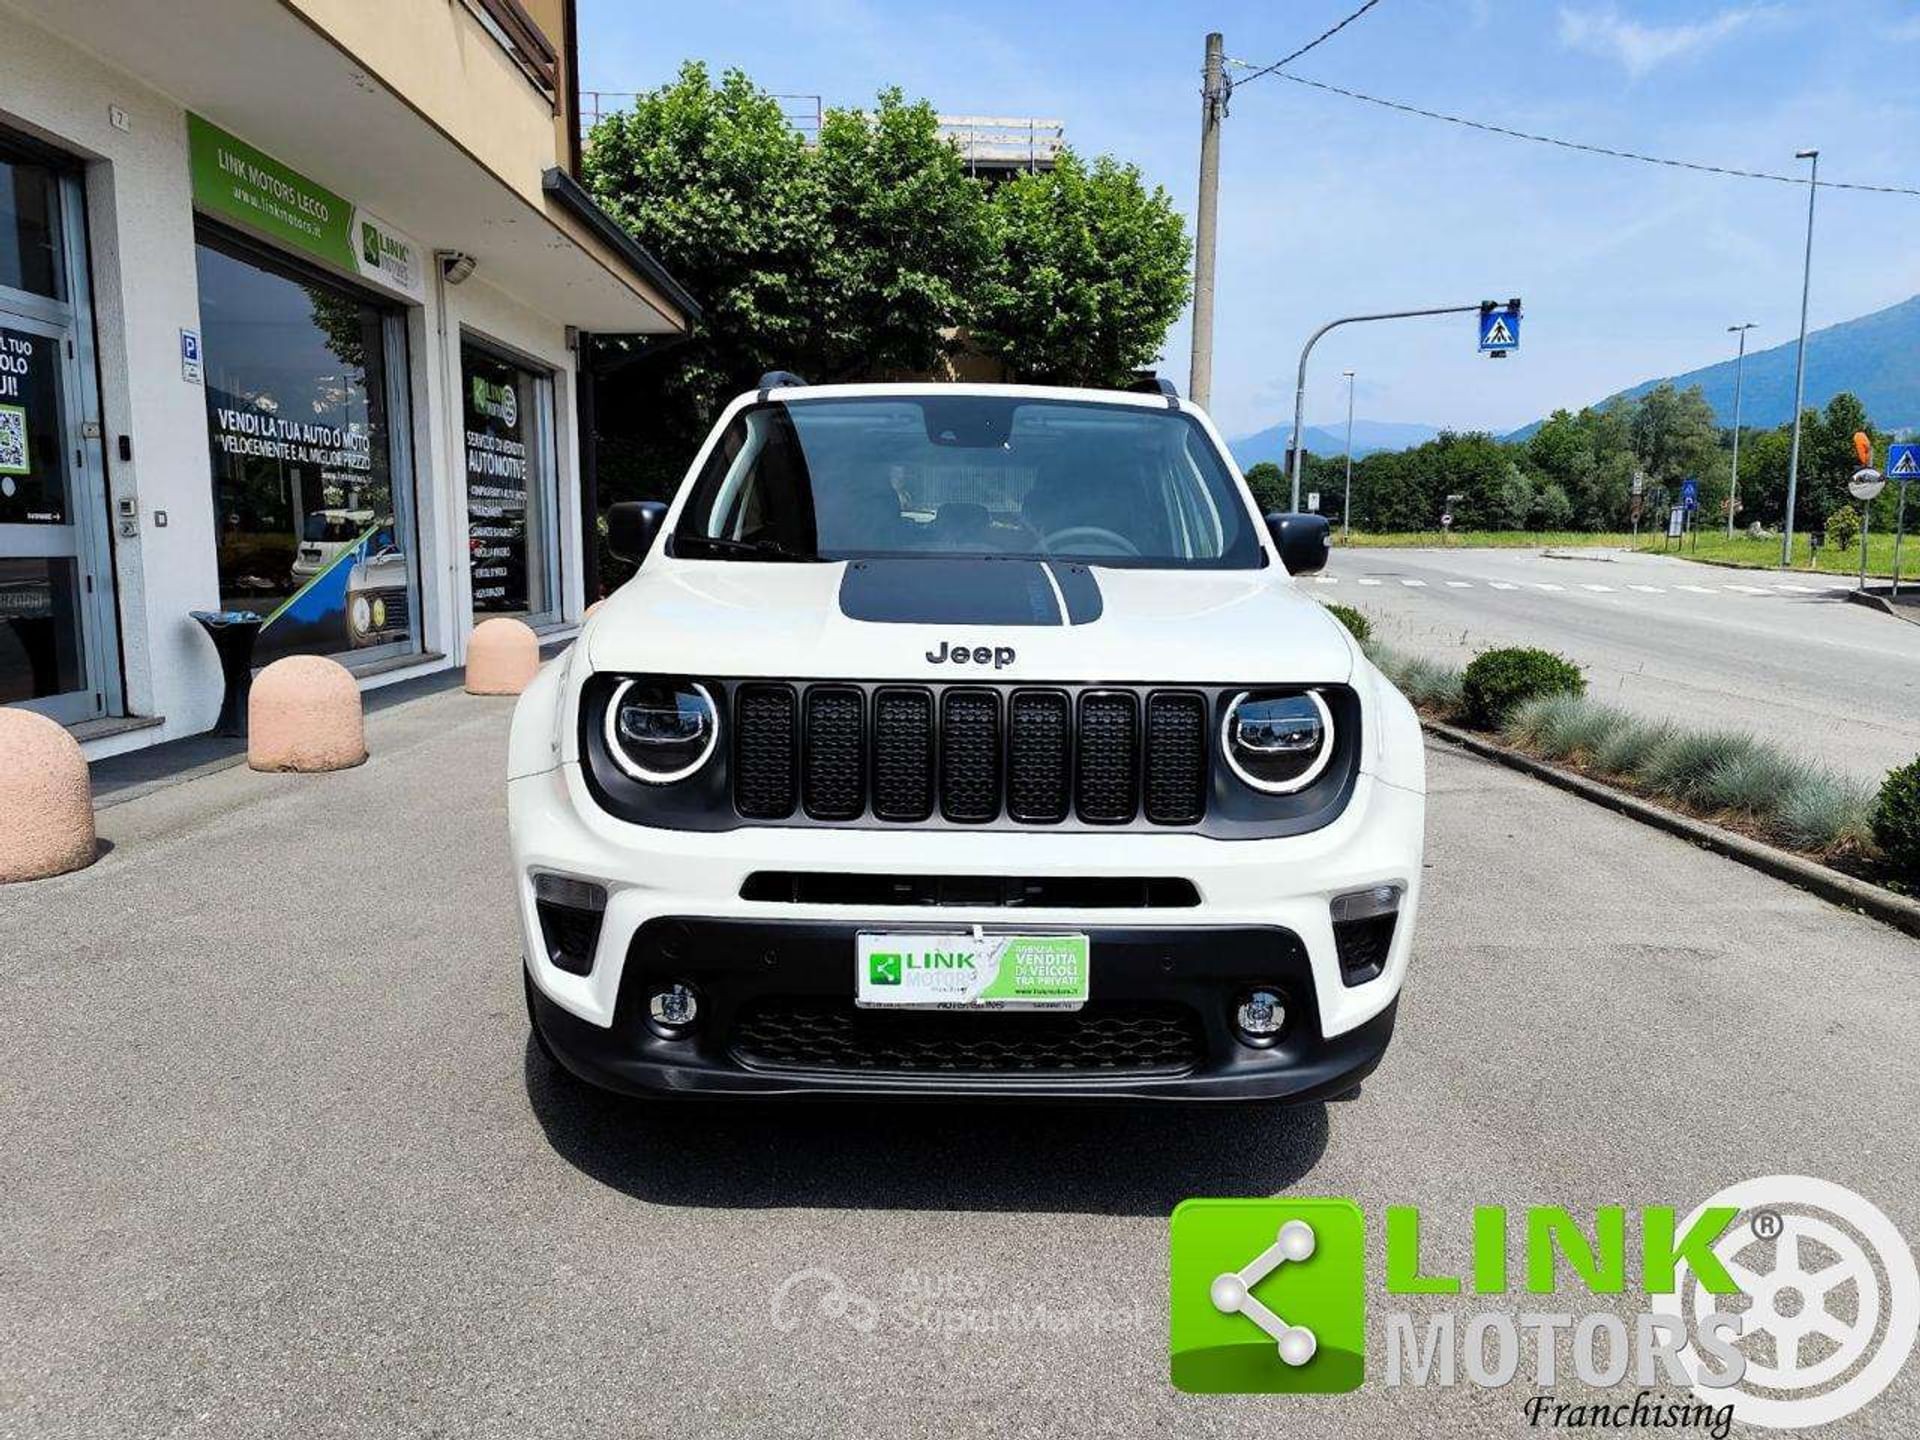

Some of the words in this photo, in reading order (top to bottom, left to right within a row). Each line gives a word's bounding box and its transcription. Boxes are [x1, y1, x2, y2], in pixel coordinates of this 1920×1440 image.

[218, 148, 247, 180] LINK
[248, 165, 296, 205] MOTORS
[297, 191, 329, 222] LECCO
[379, 232, 409, 263] LINK
[8, 337, 33, 356] TUO
[186, 338, 195, 357] P
[217, 407, 260, 436] VENDI
[260, 415, 278, 438] LA
[278, 419, 301, 441] TUA
[302, 423, 332, 448] AUTO
[341, 431, 371, 452] MOTO
[219, 433, 291, 460] VELOCEMENTE
[467, 447, 527, 480] AUTOMOTIVE
[925, 641, 1016, 670] Jeep
[907, 952, 976, 969] LINK
[1016, 953, 1077, 966] VENDITA
[1029, 965, 1078, 977] VEICOLI
[1015, 976, 1035, 986] TRA
[1037, 976, 1078, 986] PRIVATI
